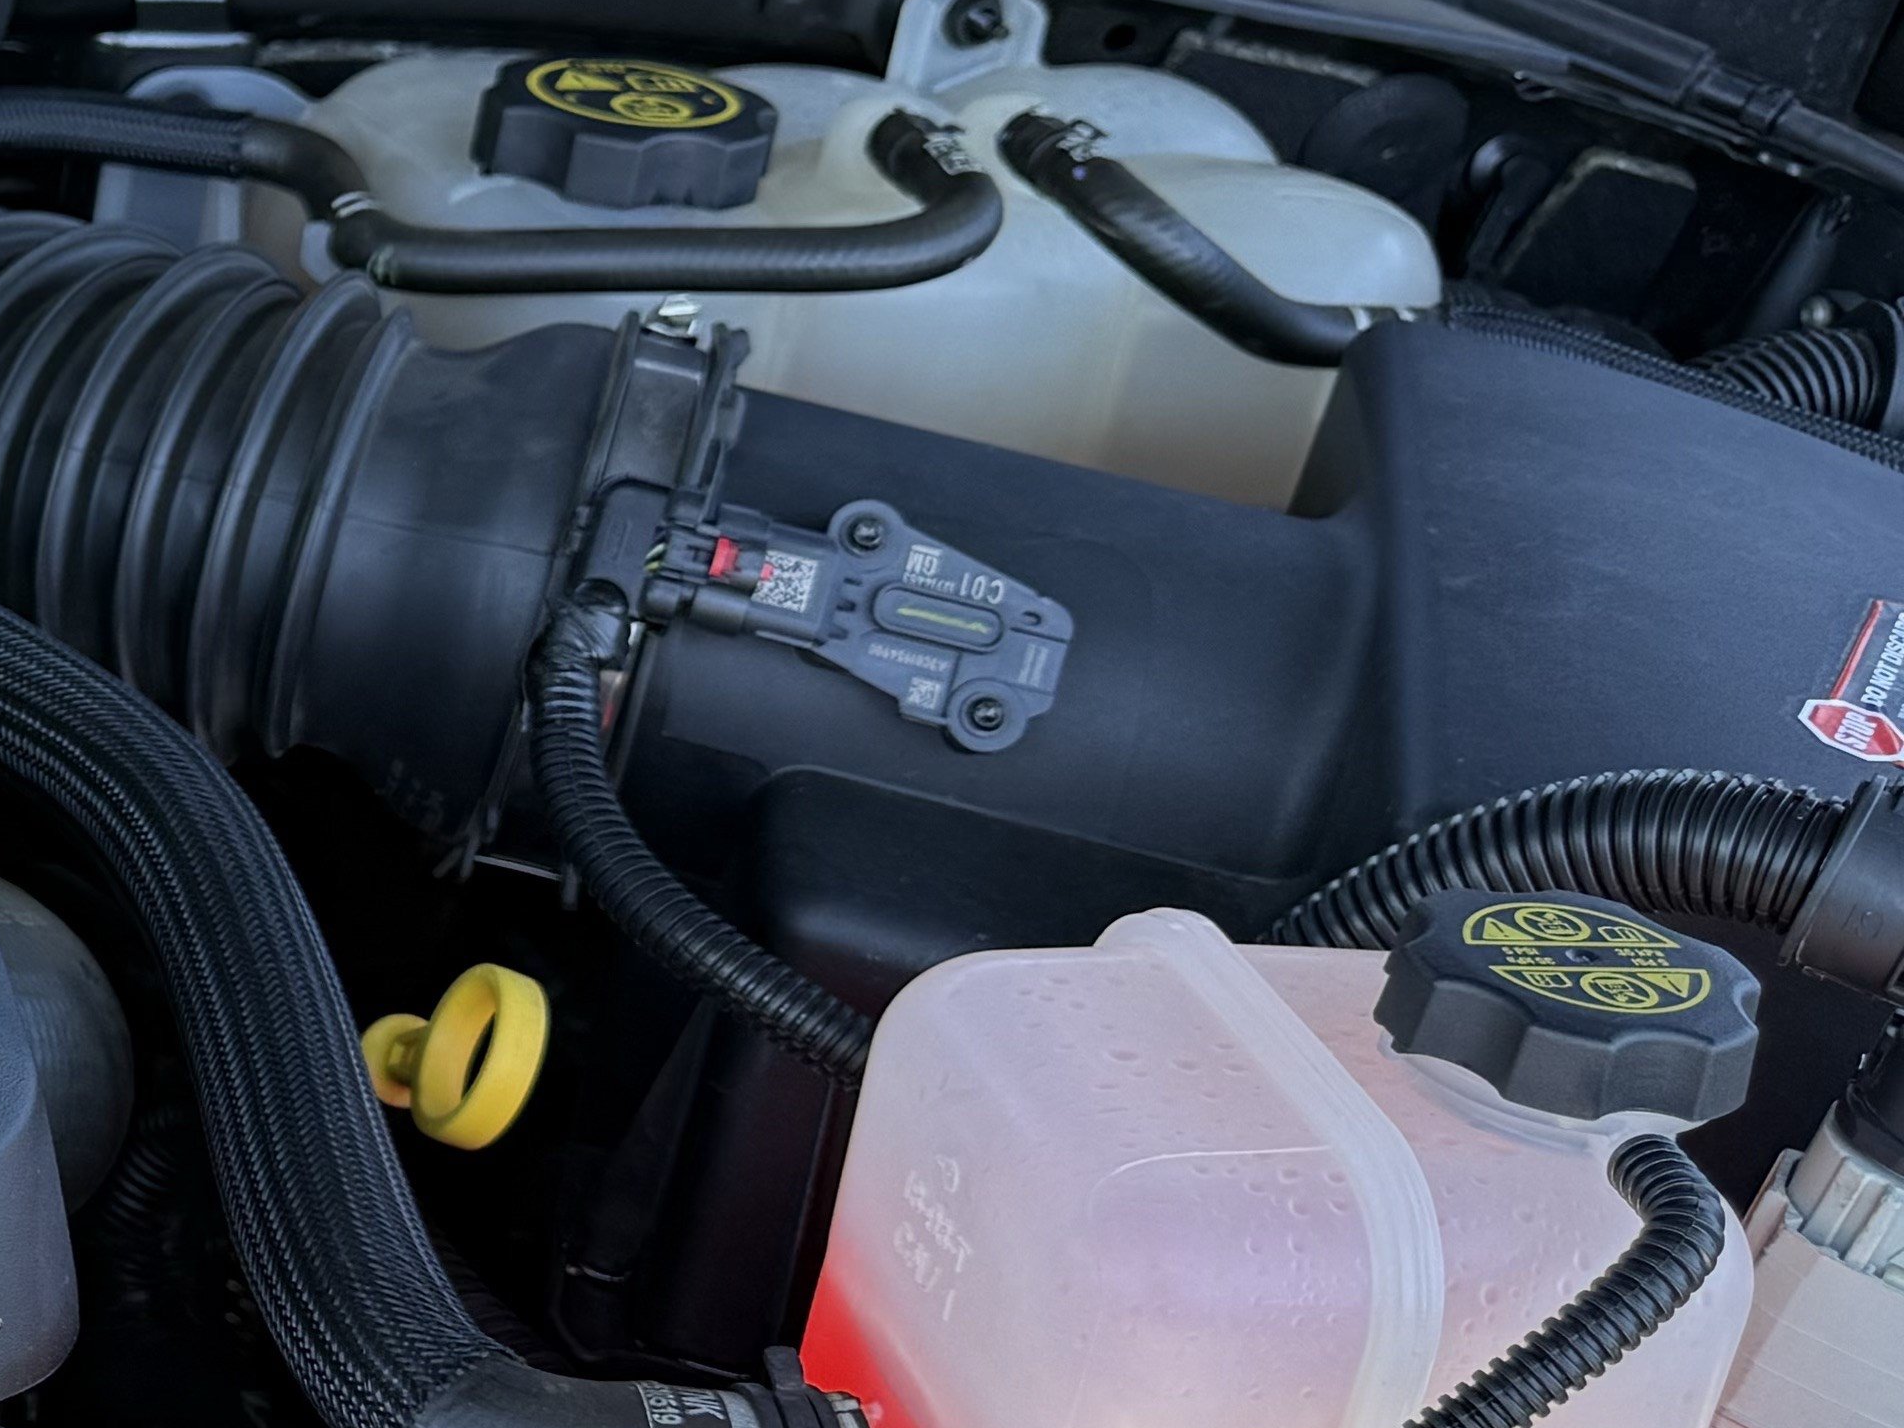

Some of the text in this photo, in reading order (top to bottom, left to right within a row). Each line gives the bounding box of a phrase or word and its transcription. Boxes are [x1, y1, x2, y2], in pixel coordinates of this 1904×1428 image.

[905, 550, 938, 577] GM
[1869, 660, 1899, 690] NOT
[1860, 686, 1887, 707] DO
[1834, 711, 1878, 751] STOP
